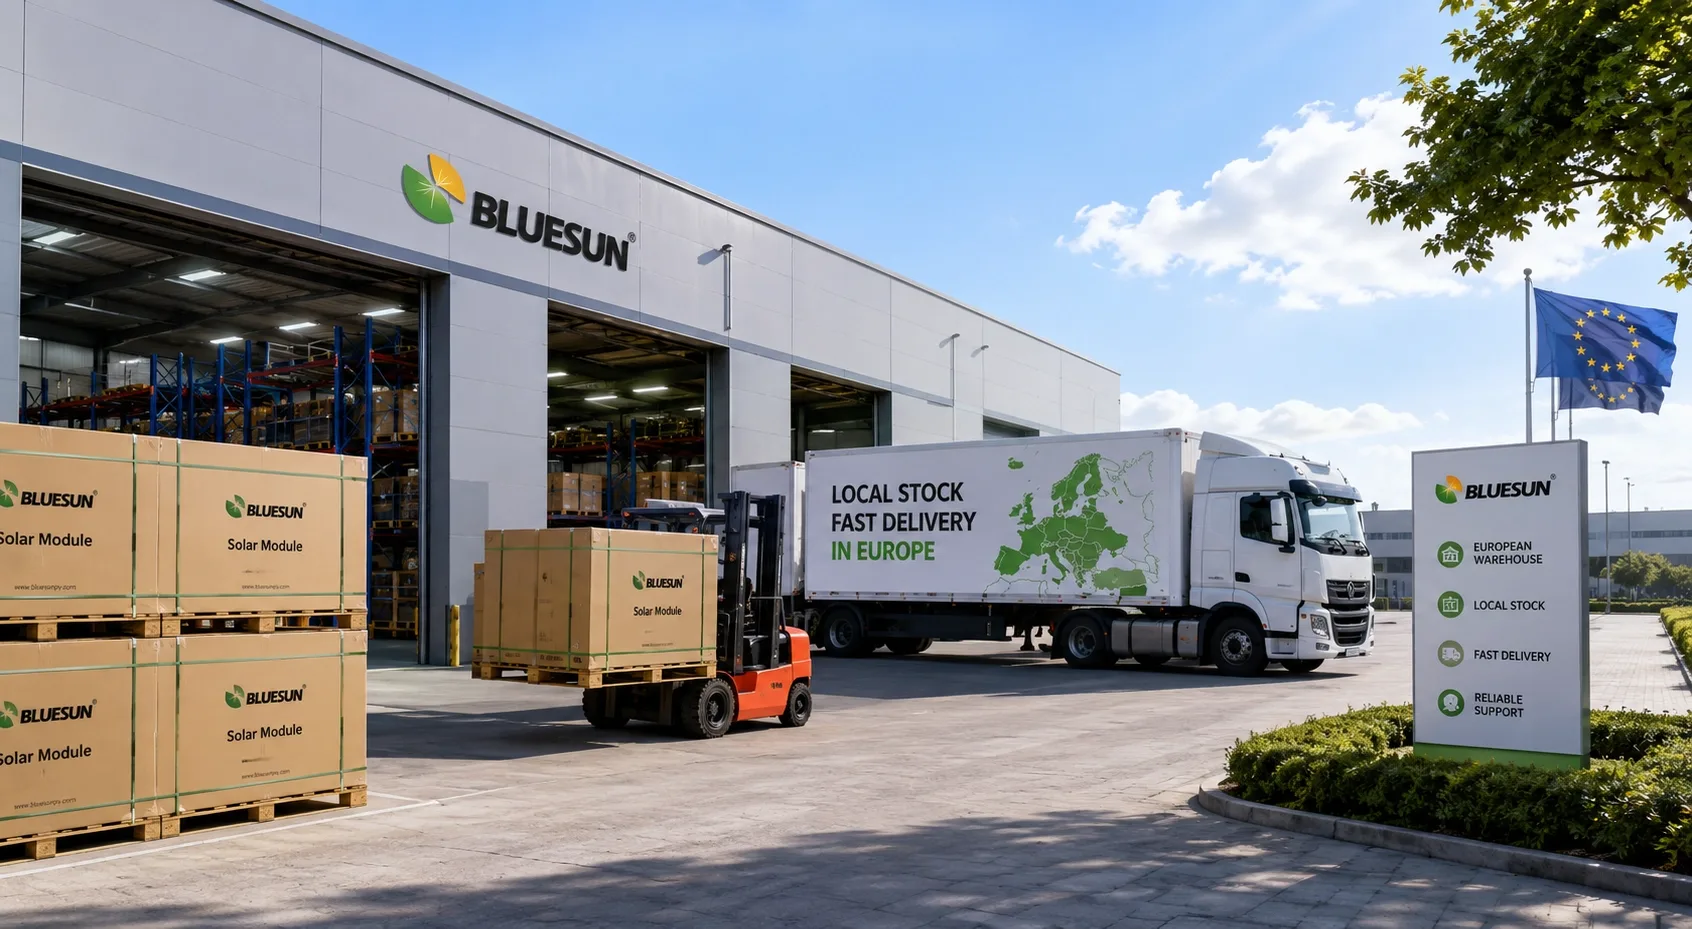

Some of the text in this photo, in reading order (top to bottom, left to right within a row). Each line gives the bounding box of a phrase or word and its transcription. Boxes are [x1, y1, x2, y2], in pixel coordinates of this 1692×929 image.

[832, 482, 964, 504] LOCAL STOCK
[831, 511, 977, 532] FAST DELIVERY
[39, 533, 93, 547] Module
[227, 538, 303, 552] Solar Module
[1473, 541, 1532, 552] EUROPEAN
[831, 541, 935, 560] IN EUROPE
[1473, 554, 1543, 565] WAREHOUSE
[633, 606, 682, 616] Solar Module
[1474, 600, 1546, 611] LOCAL STOCK
[1474, 649, 1551, 662] FAST DELIVERY
[1474, 692, 1523, 705] RELIABLE
[1474, 706, 1524, 718] SUPPORT
[227, 723, 303, 742] Solar Module
[38, 744, 92, 762] Module
